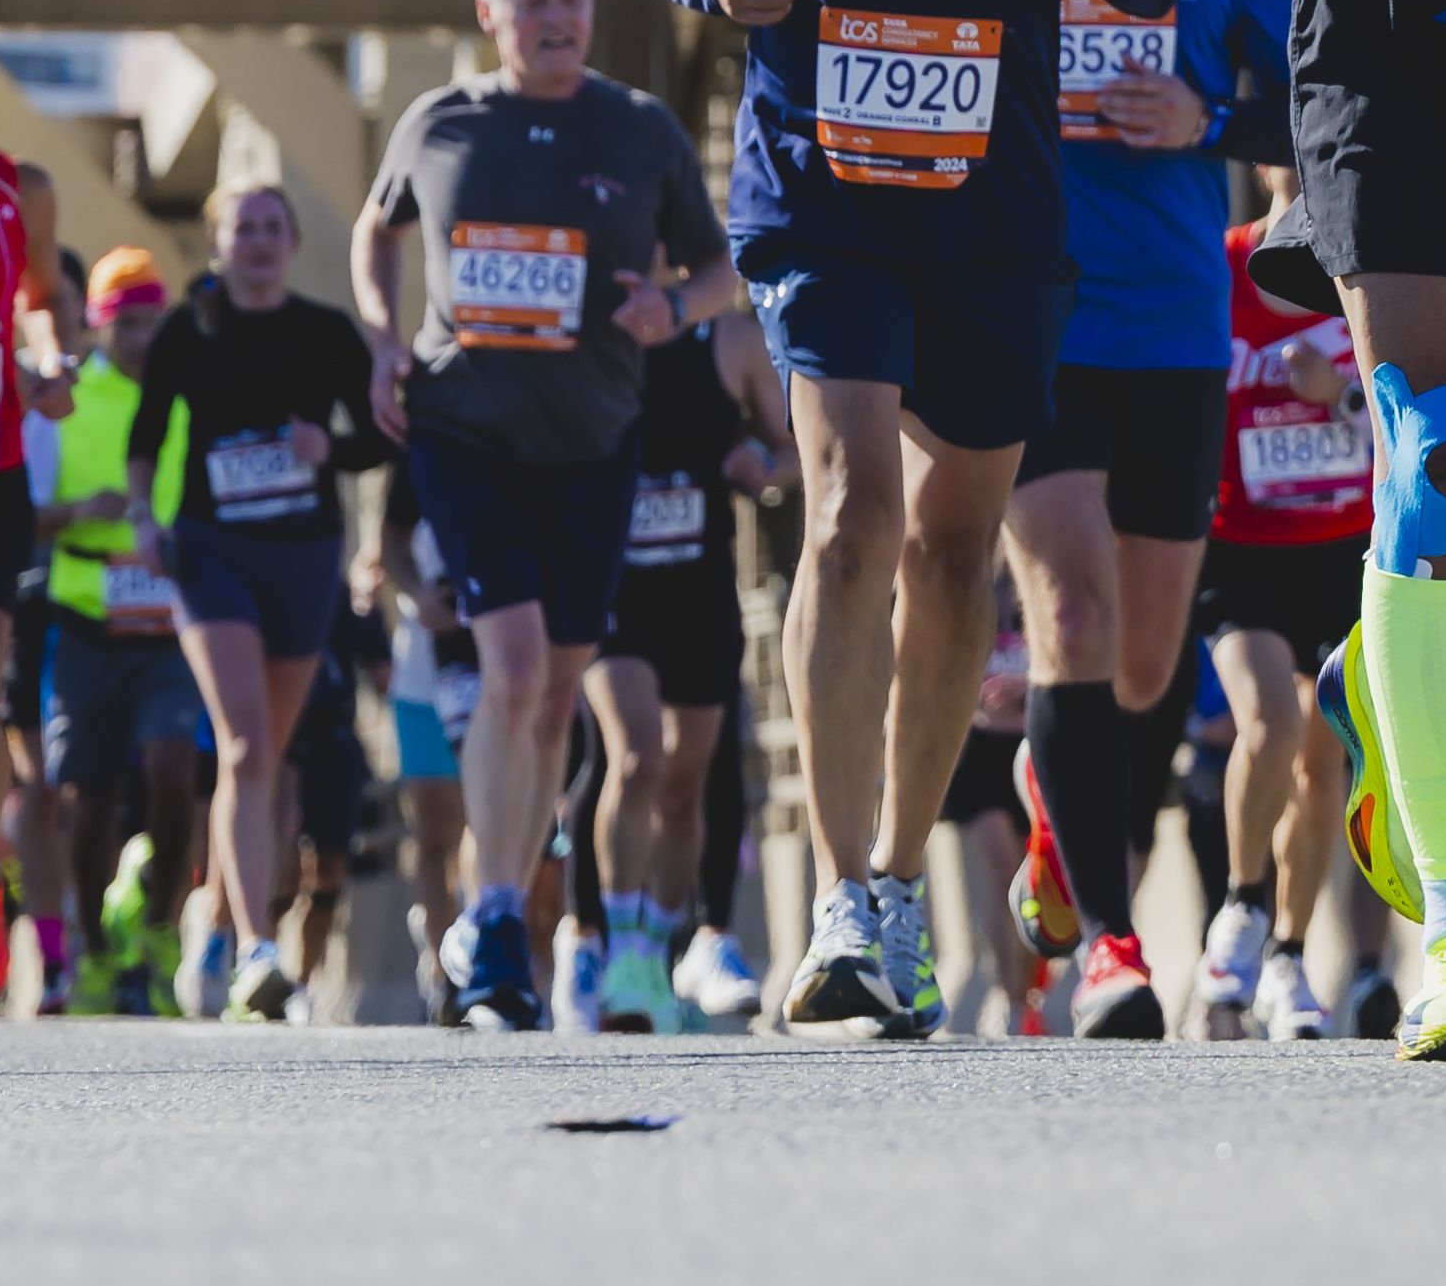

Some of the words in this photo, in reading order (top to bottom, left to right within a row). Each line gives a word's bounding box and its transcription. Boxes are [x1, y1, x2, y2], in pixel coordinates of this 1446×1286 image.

[840, 14, 878, 44] tcs
[951, 40, 981, 51] TATA
[833, 53, 982, 113] 17920
[842, 107, 852, 119] 2
[933, 157, 969, 172] 2024
[457, 252, 576, 297] 46266
